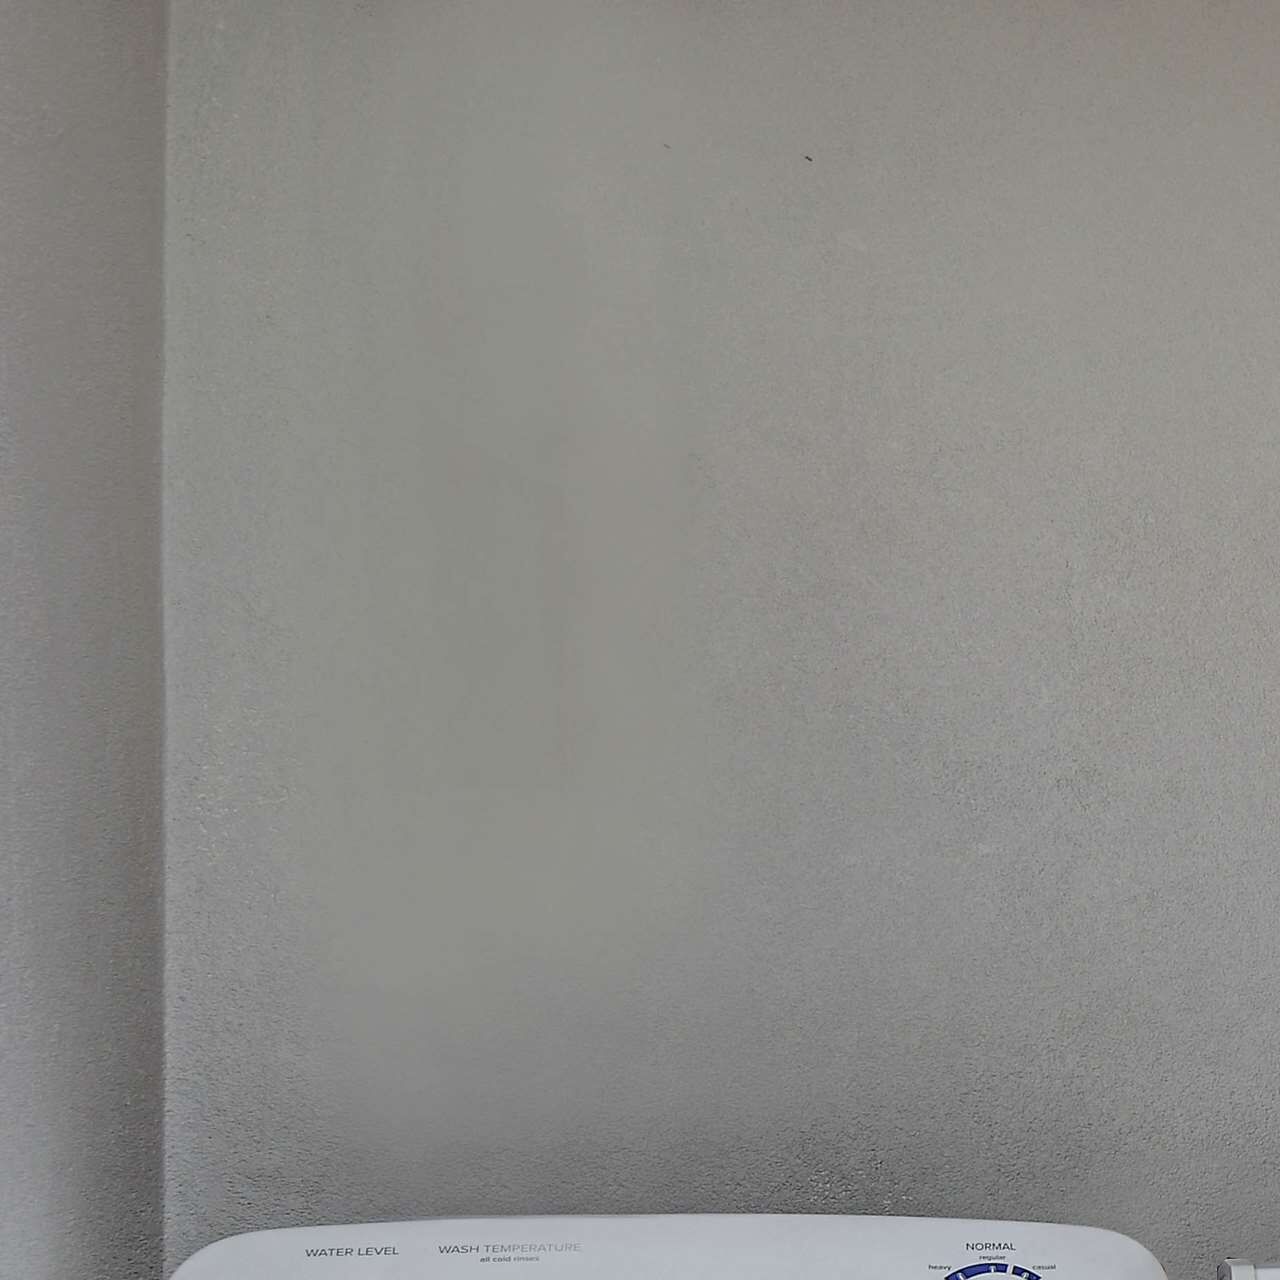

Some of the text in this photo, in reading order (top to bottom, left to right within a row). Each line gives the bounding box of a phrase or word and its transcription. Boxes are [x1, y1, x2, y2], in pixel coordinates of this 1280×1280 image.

[438, 1243, 582, 1254] WASH TEMPERATURE
[966, 1242, 1016, 1251] NORMAL
[305, 1247, 399, 1257] WATER LEVEL
